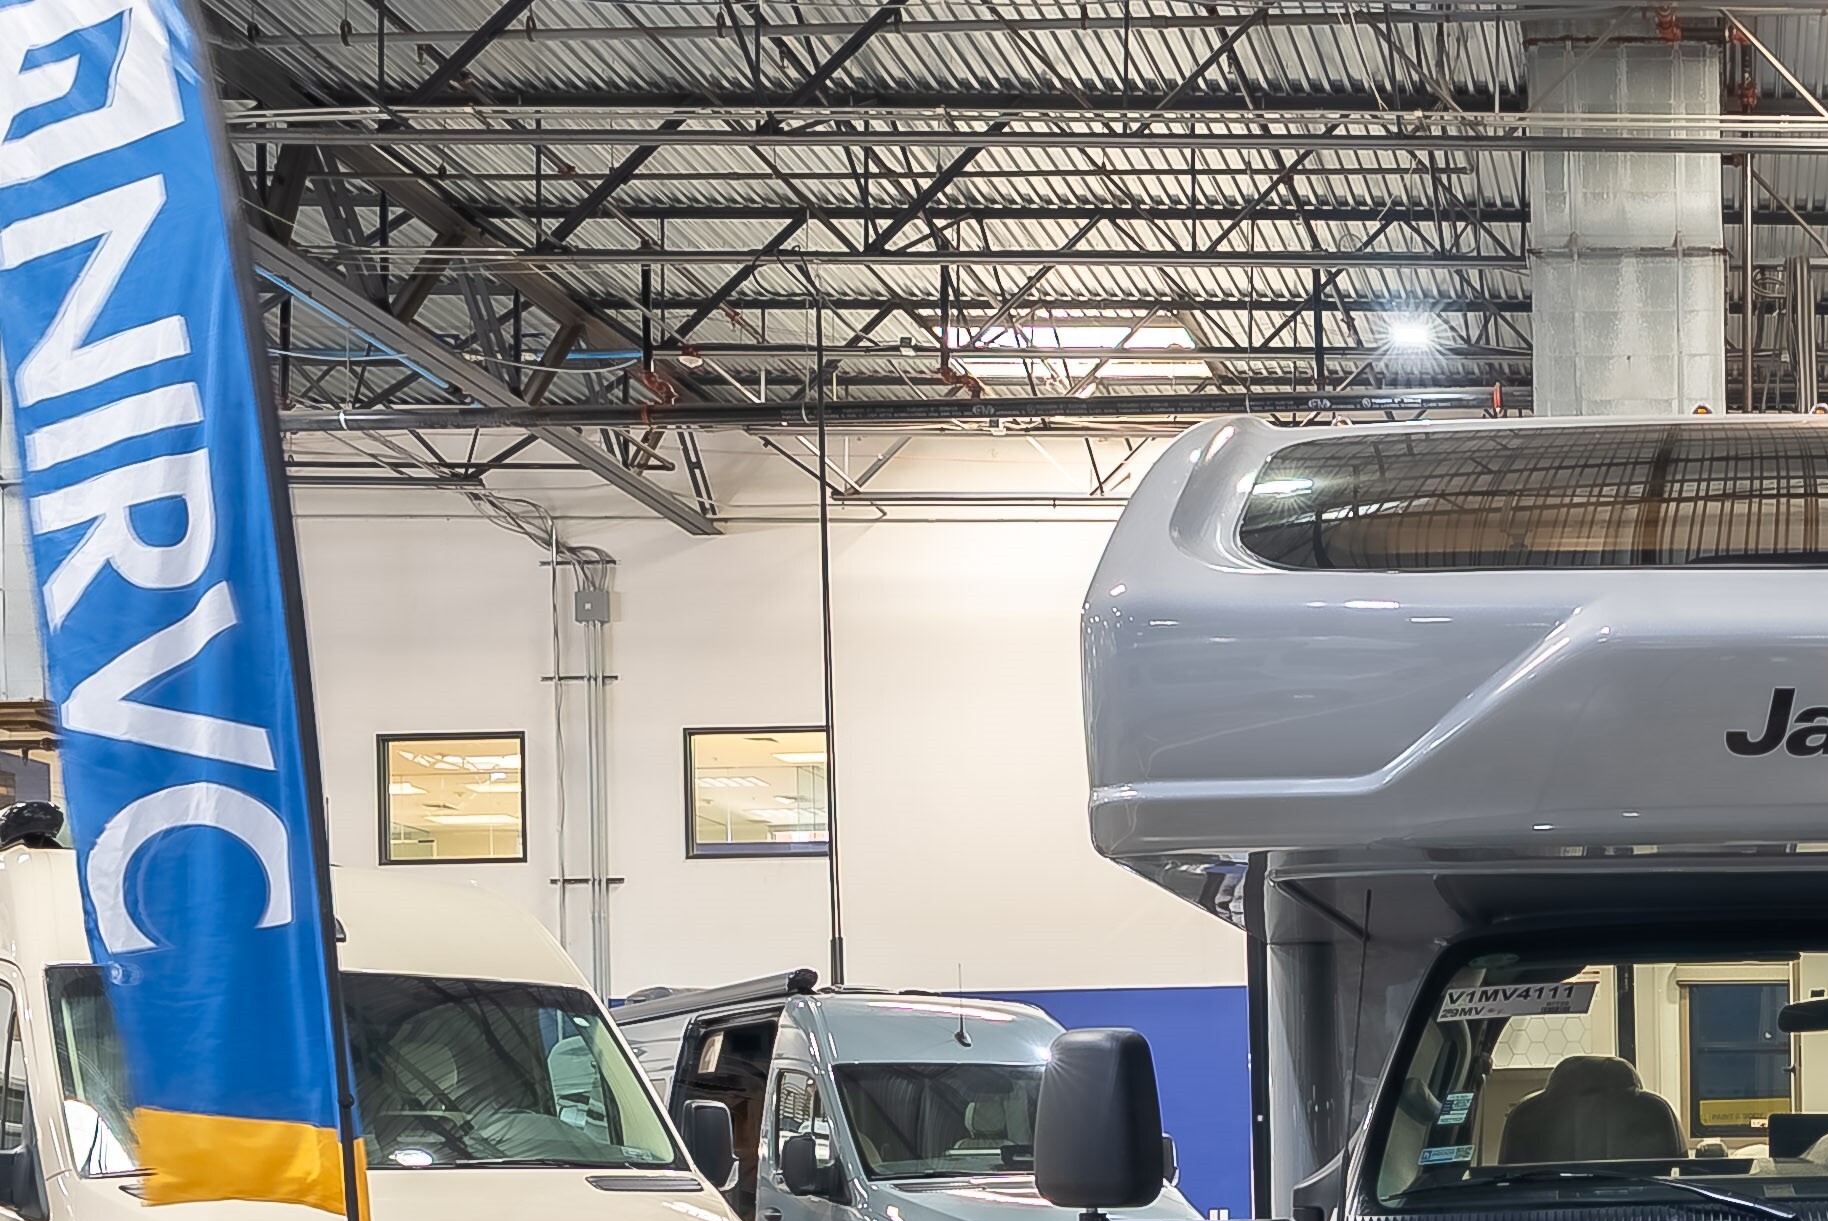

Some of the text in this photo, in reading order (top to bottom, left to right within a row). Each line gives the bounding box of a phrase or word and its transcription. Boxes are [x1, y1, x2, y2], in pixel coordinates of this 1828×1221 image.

[0, 173, 293, 954] NIRVC
[1447, 985, 1575, 1005] V1MV4111
[1440, 1006, 1486, 1019] 29MV
